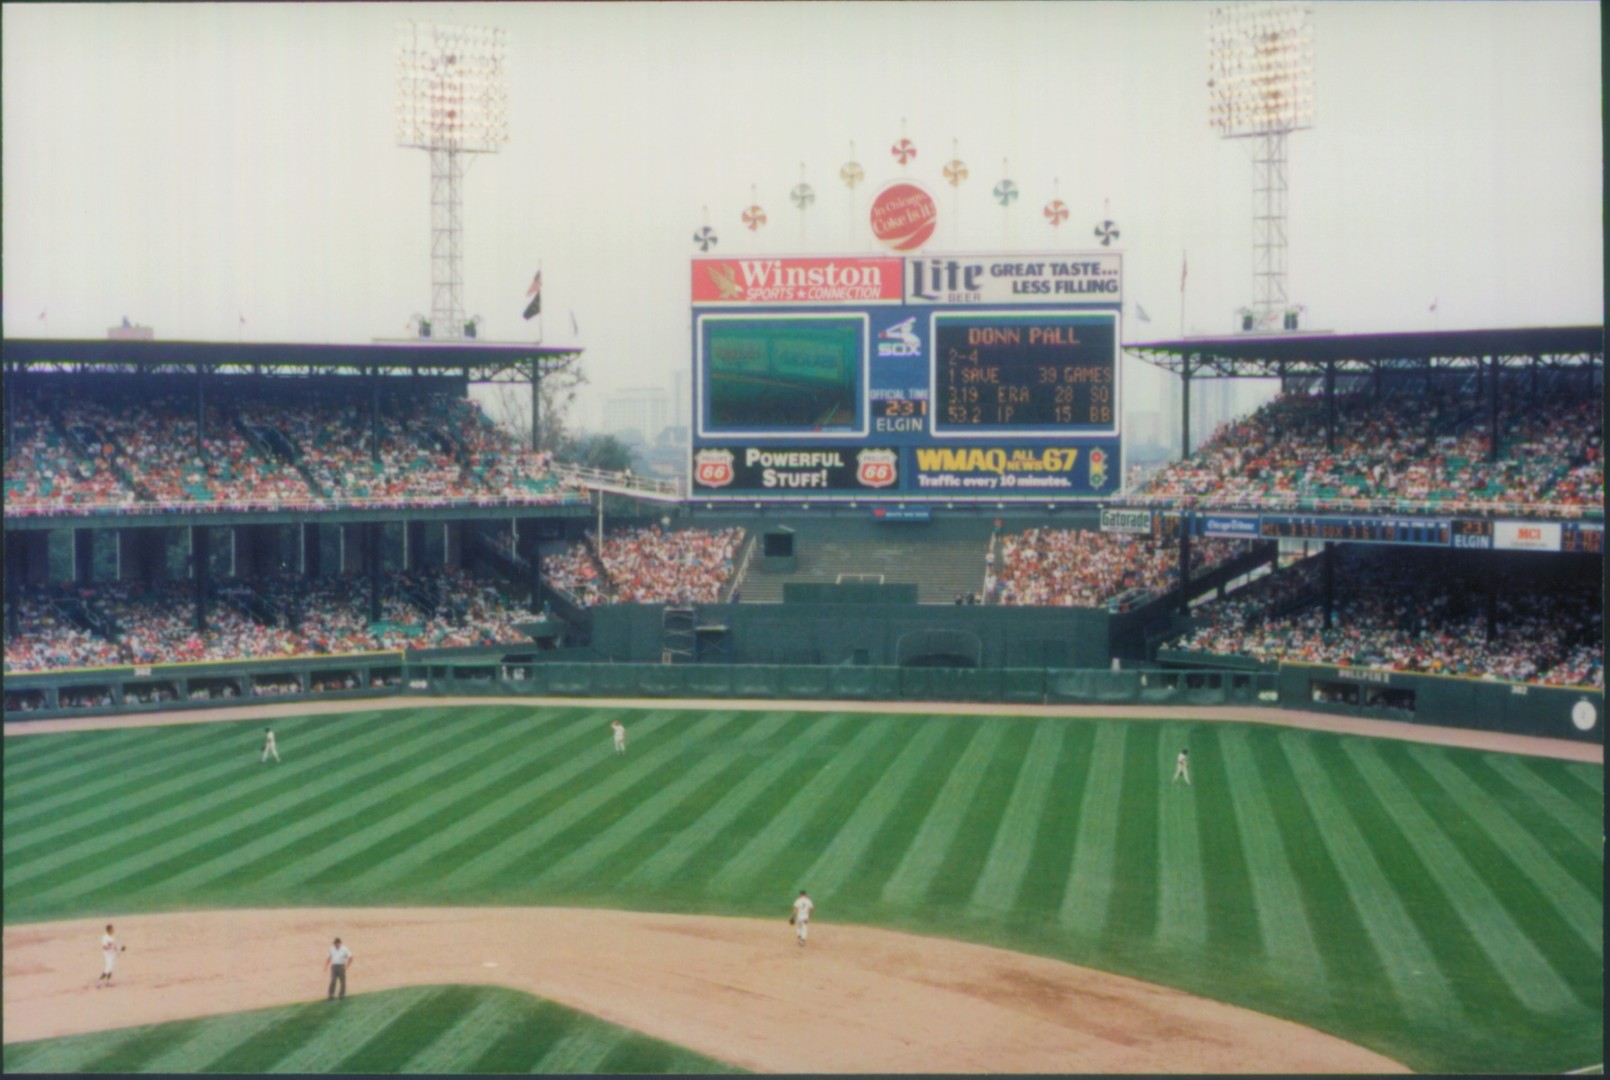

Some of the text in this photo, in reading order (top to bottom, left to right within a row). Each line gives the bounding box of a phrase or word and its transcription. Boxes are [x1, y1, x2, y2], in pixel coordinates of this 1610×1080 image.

[739, 260, 882, 288] Winston
[990, 262, 1119, 278] GREAT TASTE...
[911, 260, 984, 301] Lite
[1012, 280, 1118, 294] LESS FILLING
[746, 286, 882, 300] SPORTS CONNECTION
[948, 293, 982, 303] BEER
[968, 327, 1081, 345] DONN PALL
[878, 342, 921, 356] SOX
[949, 349, 979, 365] 2-4
[961, 367, 1000, 383] SAVE
[1039, 367, 1058, 384] 39
[1064, 367, 1113, 383] GAMES
[869, 389, 929, 400] OFFICIAL TIME
[997, 386, 1030, 403] ERA
[1055, 386, 1073, 402] 28
[997, 407, 1014, 422] IP
[1055, 406, 1072, 422] 15
[1090, 406, 1111, 422] BB
[876, 418, 923, 432] ELGIN
[916, 448, 1007, 473] WMAQ
[1043, 449, 1078, 471] 67
[703, 465, 726, 480] 66
[864, 465, 889, 480] 66
[918, 474, 960, 487] Traffic
[963, 476, 997, 489] every
[1000, 474, 1016, 487] 10
[1102, 511, 1150, 528] Gatorade
[1454, 534, 1490, 549] ELGIN
[1517, 528, 1541, 540] MCI
